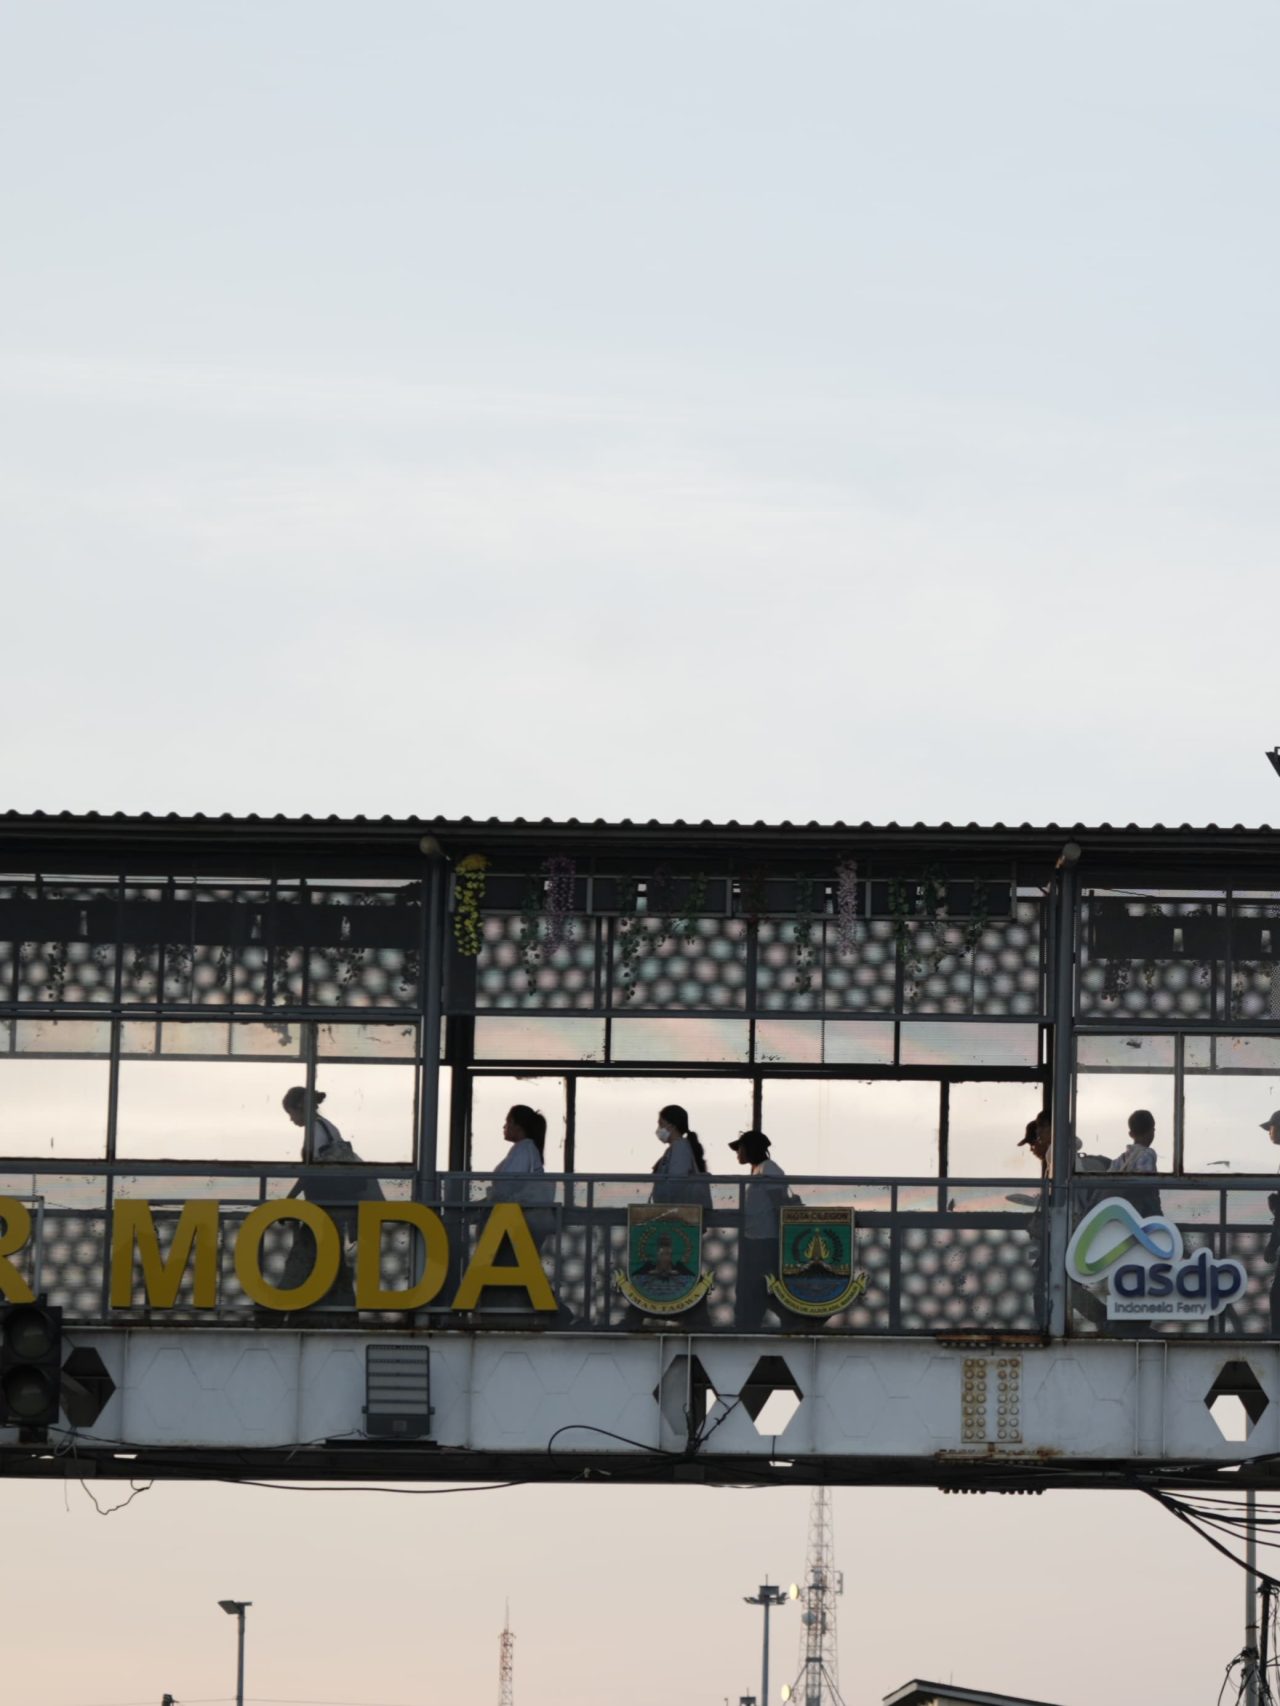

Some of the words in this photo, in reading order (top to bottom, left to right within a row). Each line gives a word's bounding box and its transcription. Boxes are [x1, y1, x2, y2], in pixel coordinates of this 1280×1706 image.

[110, 1198, 558, 1311] MODA
[1113, 1252, 1242, 1310] asdp
[1114, 1302, 1173, 1313] Indonesia
[1176, 1302, 1207, 1314] Ferry
